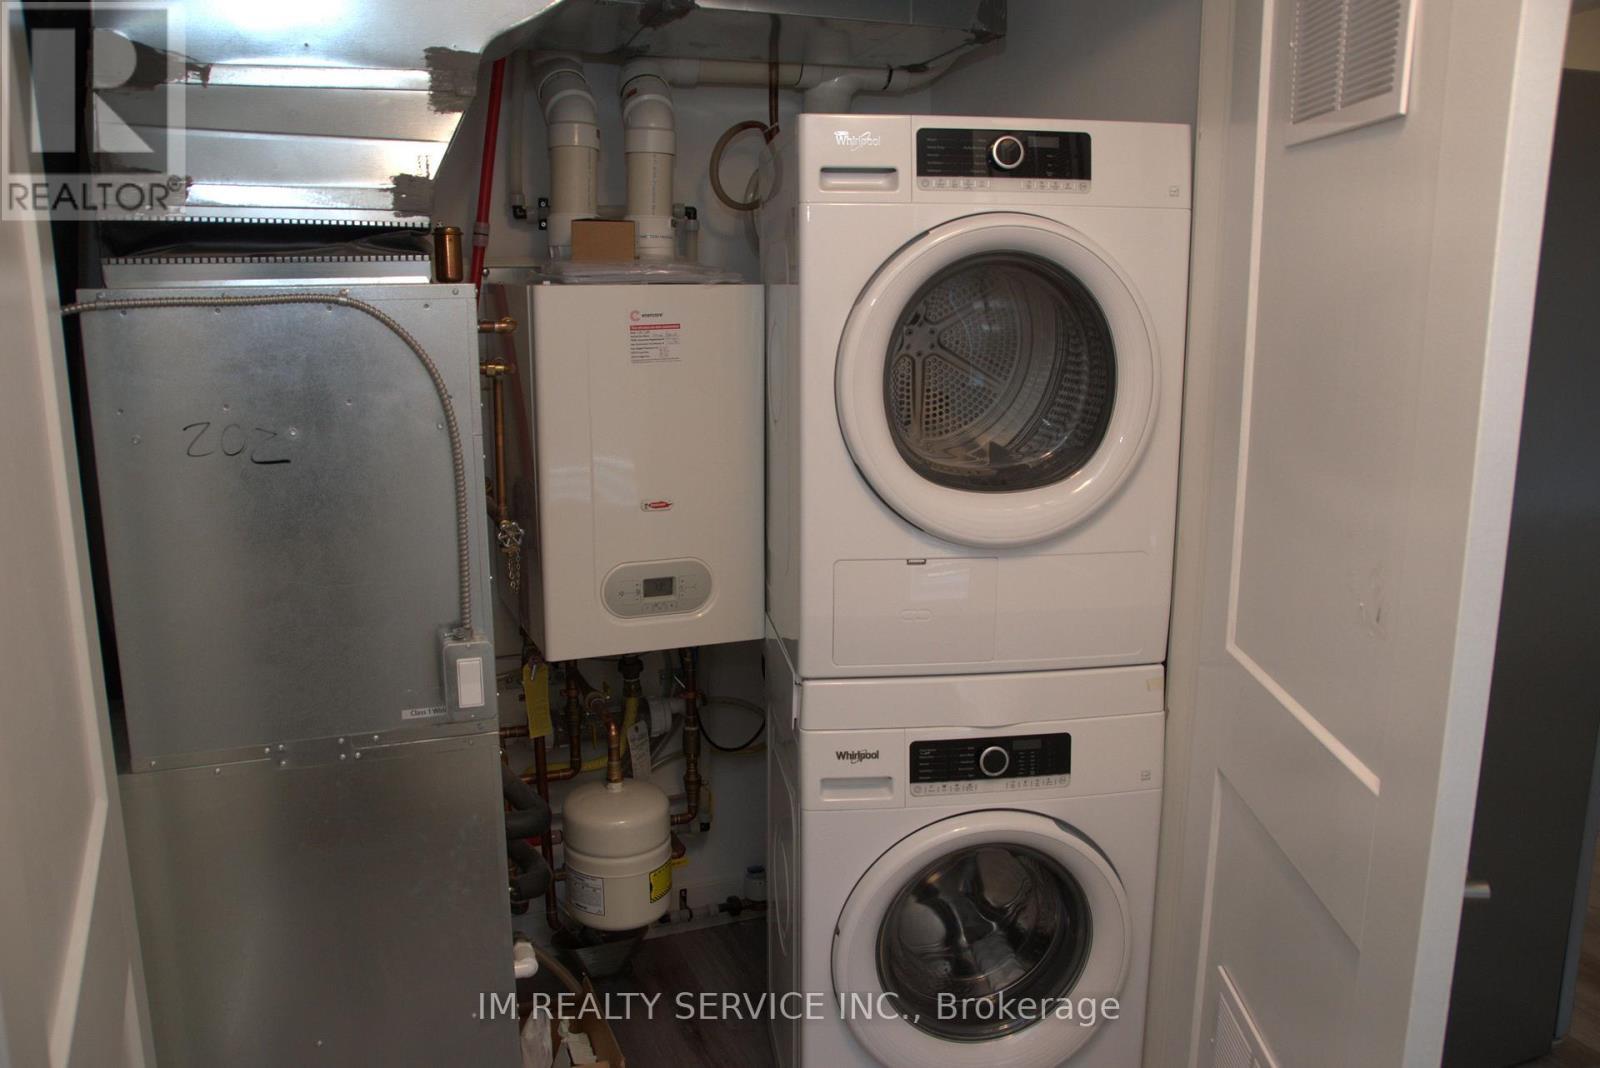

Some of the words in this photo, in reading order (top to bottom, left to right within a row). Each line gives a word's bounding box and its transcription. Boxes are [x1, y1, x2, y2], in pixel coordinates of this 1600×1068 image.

[834, 132, 880, 148] Whirlpool
[182, 421, 291, 464] 202
[836, 750, 879, 763] Whirlpool
